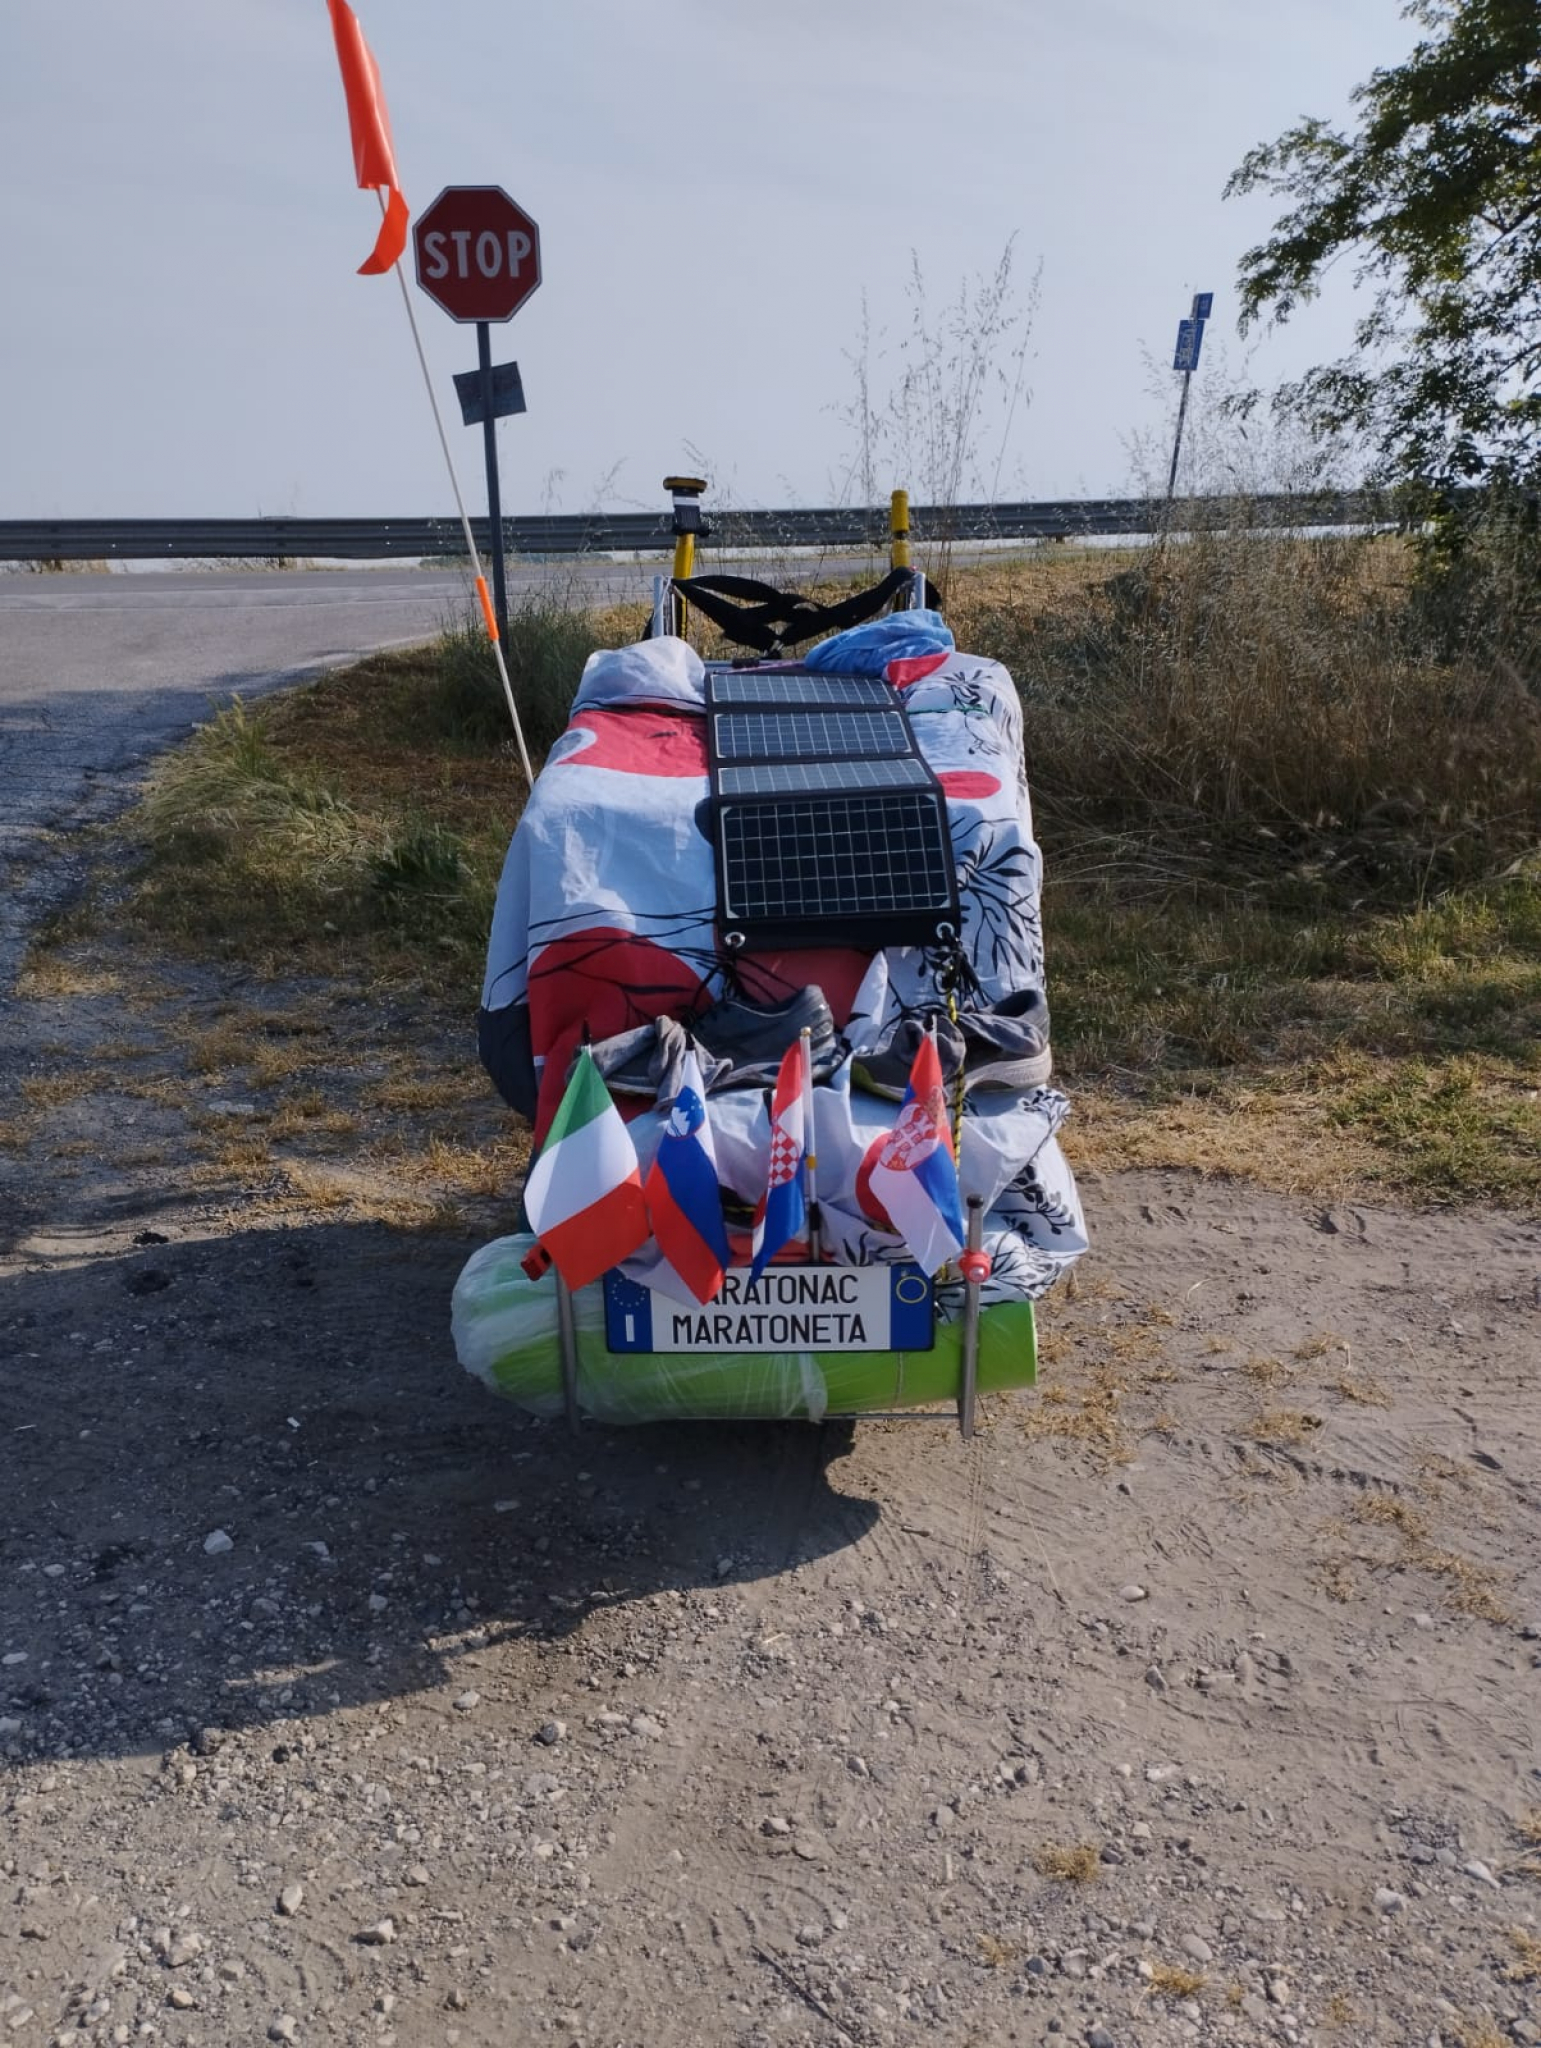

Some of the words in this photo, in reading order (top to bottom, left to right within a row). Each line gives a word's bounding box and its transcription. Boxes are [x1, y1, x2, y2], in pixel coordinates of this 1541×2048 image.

[425, 231, 530, 278] STOP
[711, 1275, 858, 1304] RATONAC
[625, 1314, 635, 1342] I
[673, 1314, 867, 1344] MARATONETA
